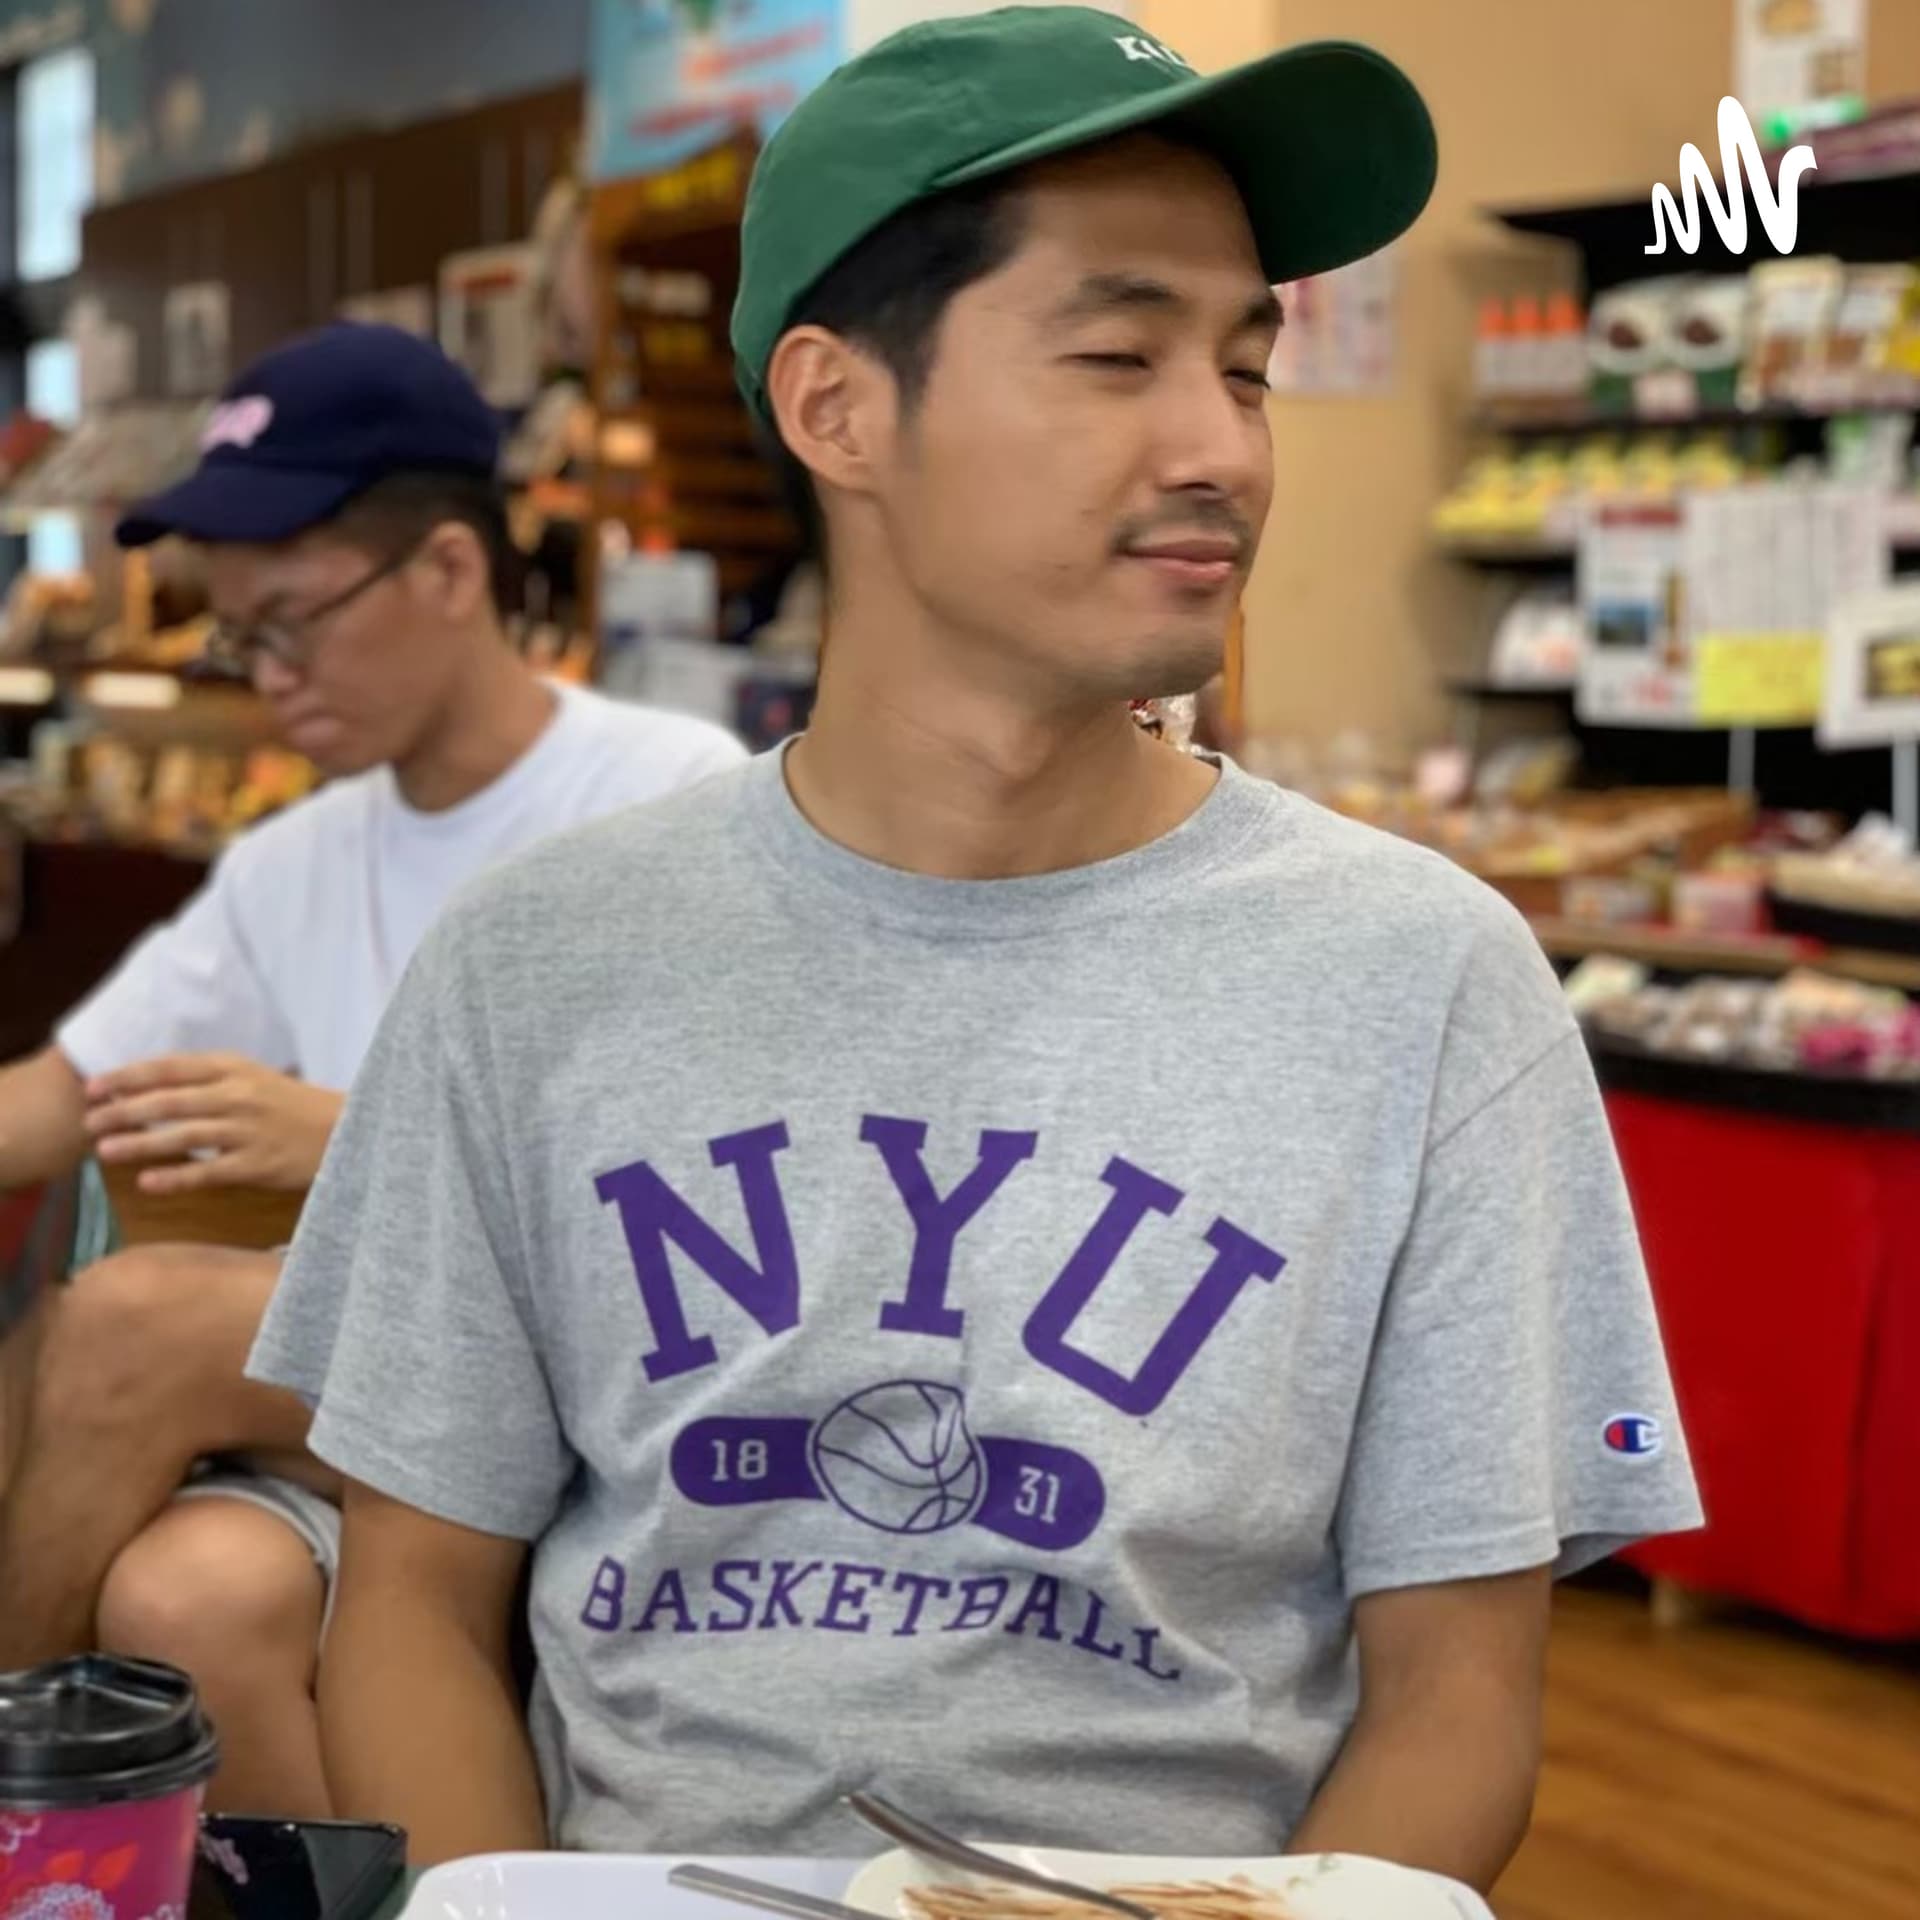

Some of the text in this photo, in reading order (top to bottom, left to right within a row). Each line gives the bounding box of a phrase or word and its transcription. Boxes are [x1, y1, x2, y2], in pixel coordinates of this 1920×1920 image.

[594, 1114, 1288, 1417] NYU
[711, 1439, 1060, 1523] 18 31
[580, 1555, 1181, 1680] BASKETBALL
